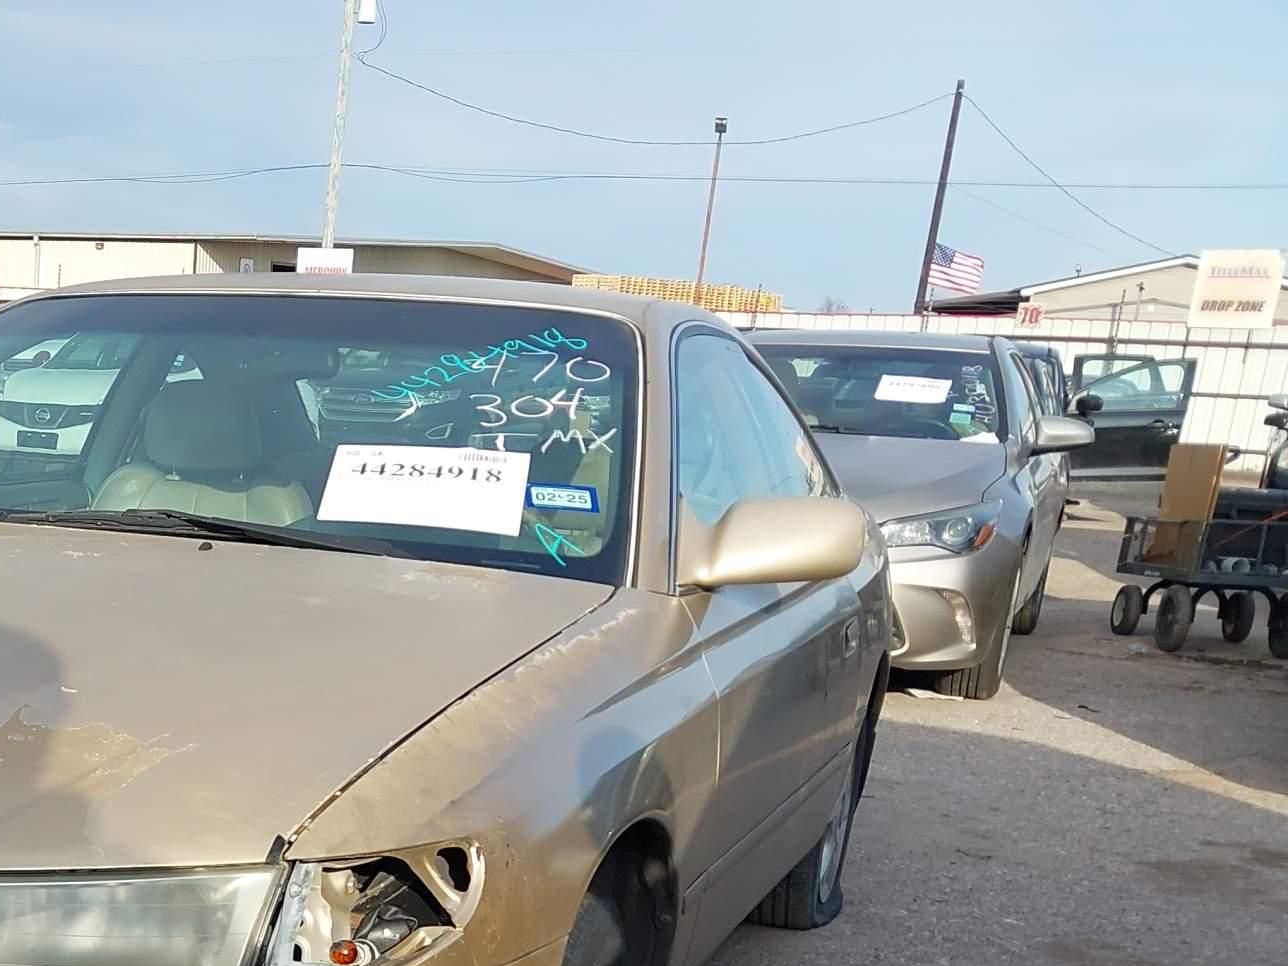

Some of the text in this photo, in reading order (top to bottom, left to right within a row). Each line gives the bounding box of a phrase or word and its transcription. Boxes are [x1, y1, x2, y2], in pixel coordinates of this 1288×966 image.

[1201, 300, 1266, 312] DROP ZONE
[469, 387, 584, 427] 304
[352, 462, 502, 483] 44284918
[535, 491, 588, 505] 02 25
